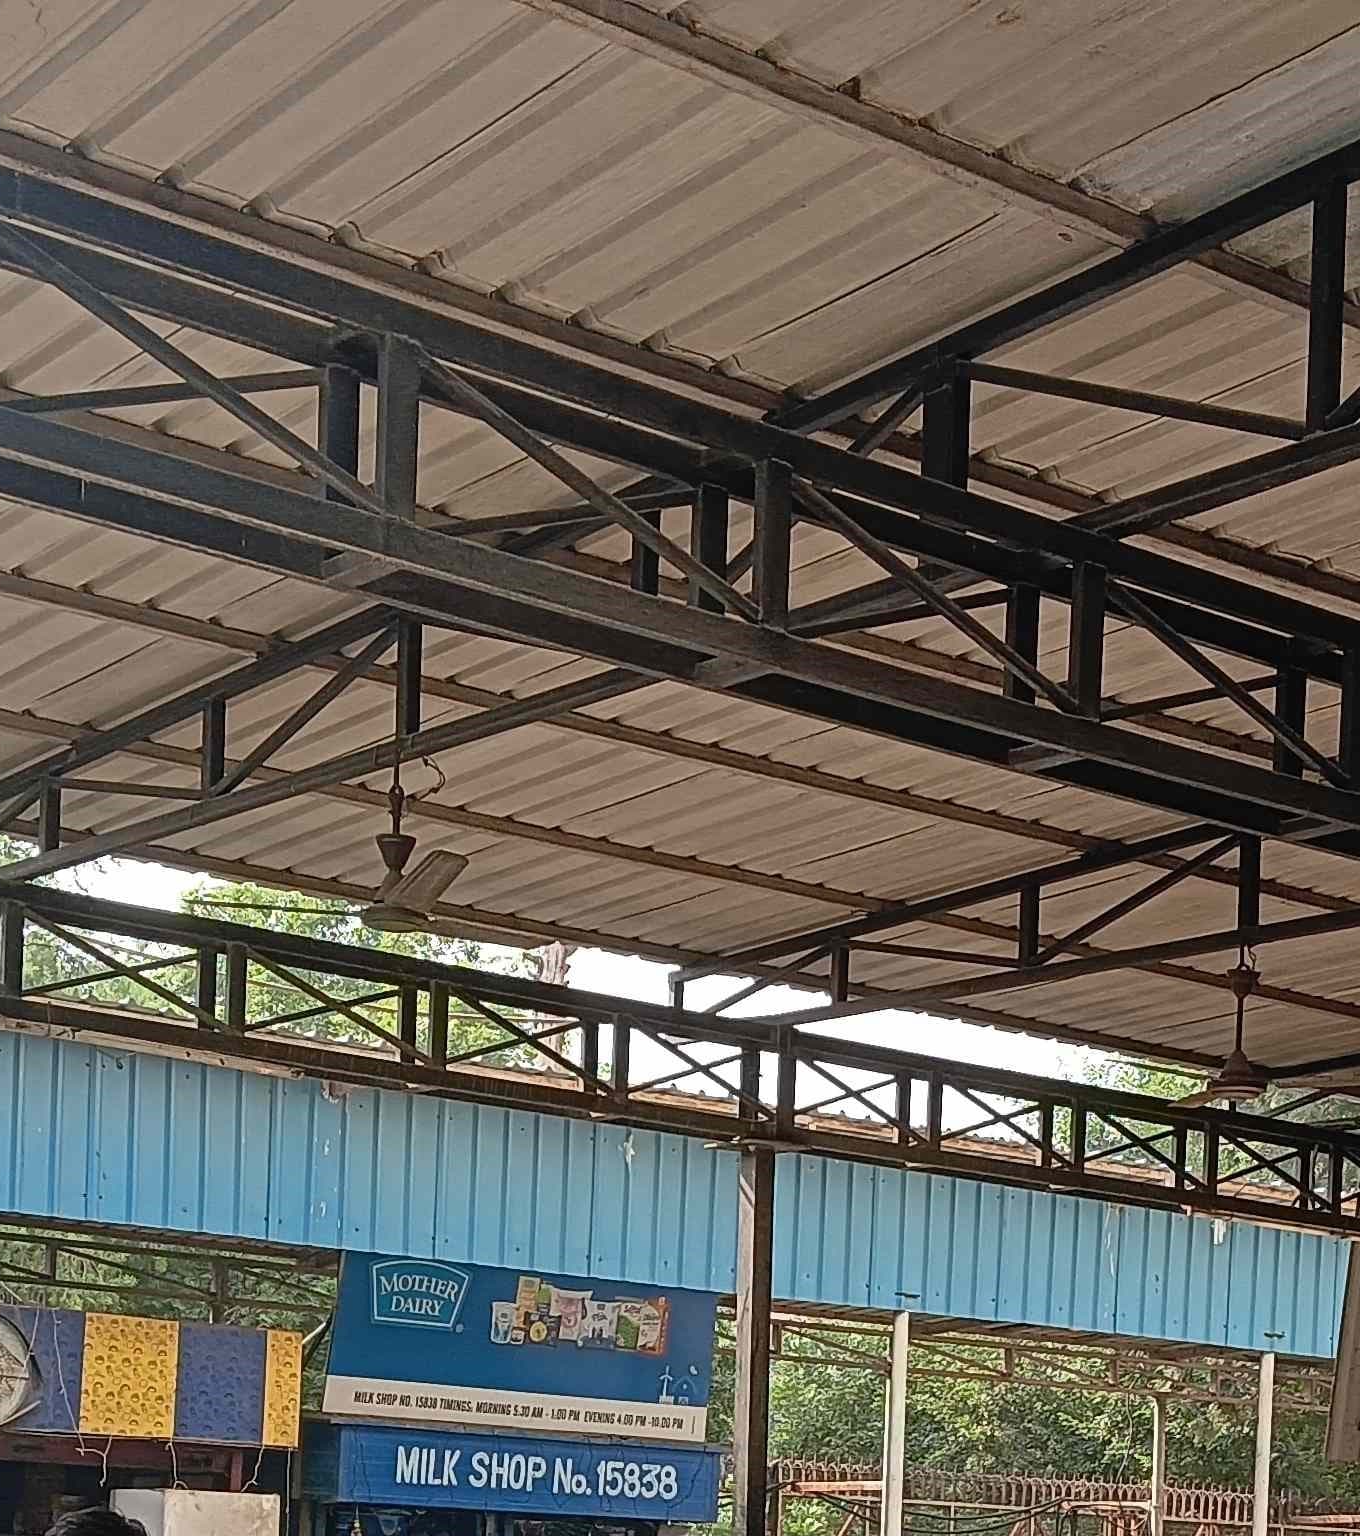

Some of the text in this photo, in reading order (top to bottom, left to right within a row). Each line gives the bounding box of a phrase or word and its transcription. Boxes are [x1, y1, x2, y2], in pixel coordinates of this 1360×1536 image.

[380, 1272, 458, 1302] MOTHER
[391, 1295, 445, 1317] DAIRY
[353, 1391, 374, 1404] MILK
[376, 1392, 397, 1406] SHOP
[415, 1396, 438, 1410] 15838
[475, 1401, 511, 1416] MORNING
[531, 1406, 544, 1418] AM
[569, 1410, 581, 1422] PM
[584, 1411, 616, 1425] EVENING
[396, 1446, 462, 1487] MILK
[468, 1450, 547, 1491] SHOP
